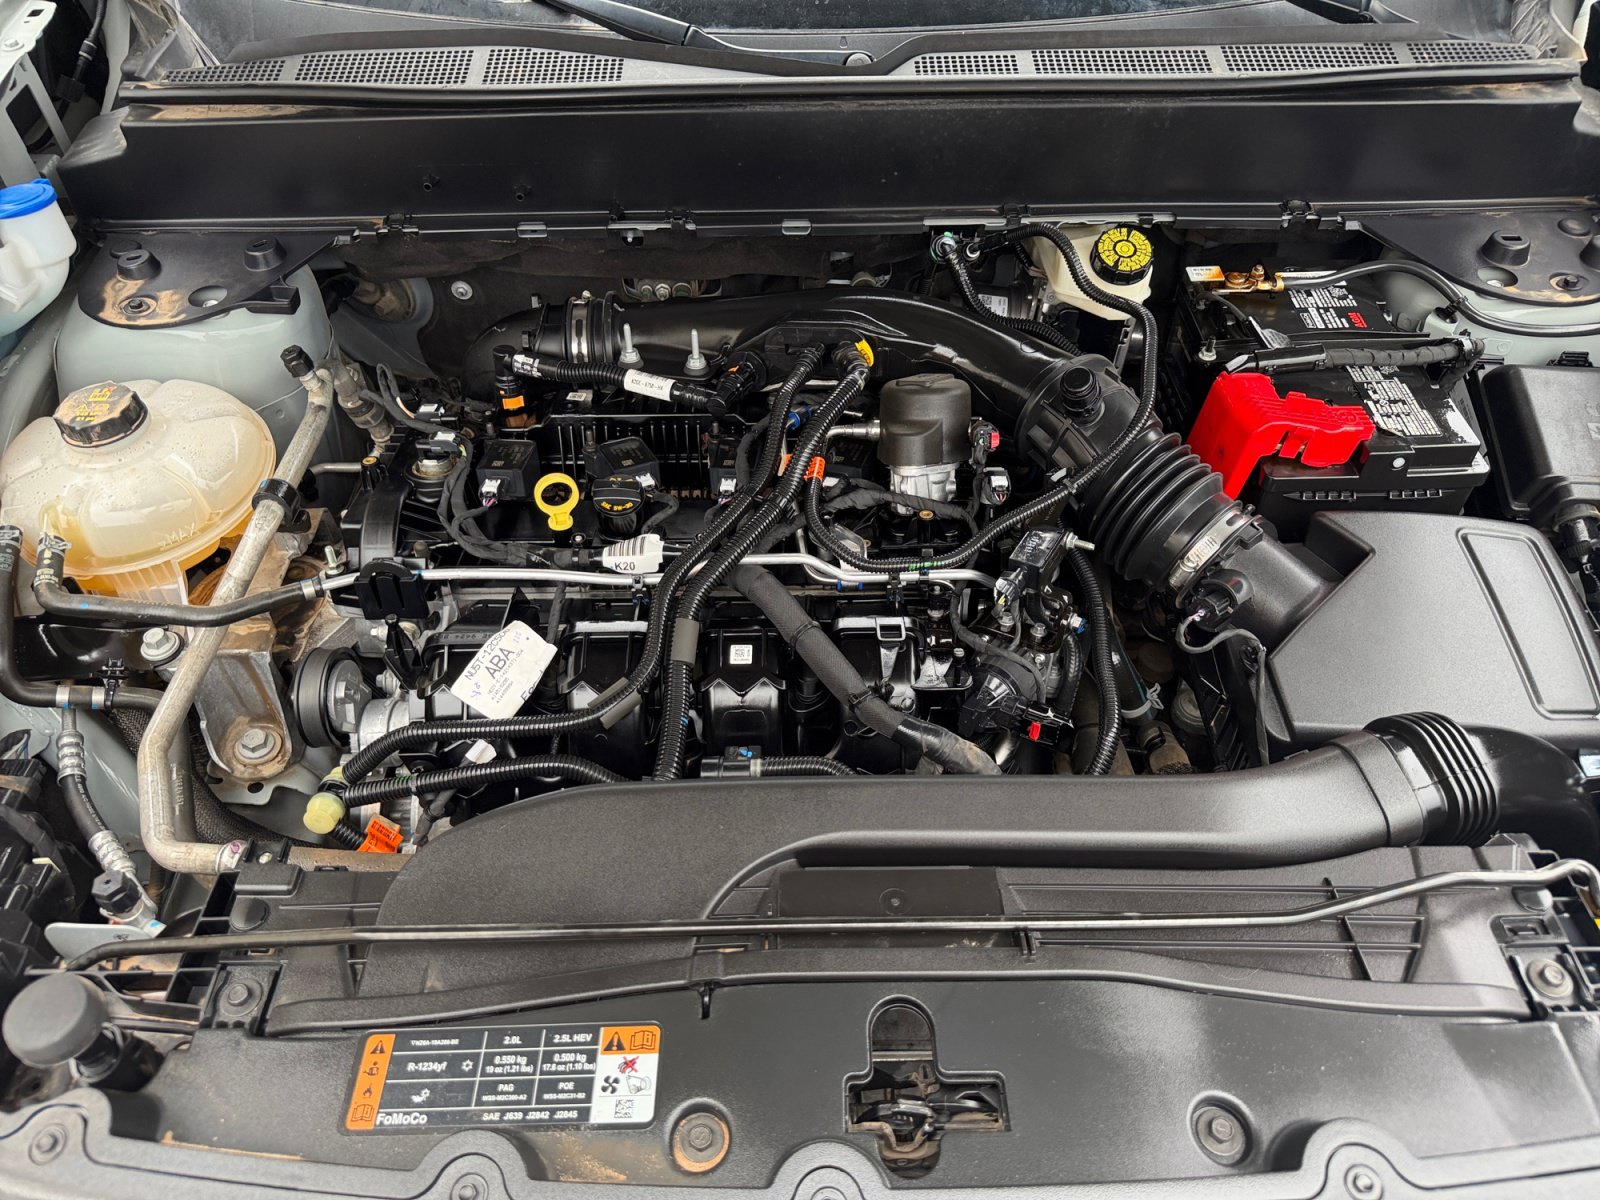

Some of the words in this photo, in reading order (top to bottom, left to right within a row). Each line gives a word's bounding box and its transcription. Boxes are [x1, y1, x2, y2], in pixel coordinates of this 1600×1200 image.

[166, 521, 200, 545] MAX
[614, 561, 636, 571] K20
[484, 647, 515, 680] ABA
[503, 1035, 522, 1045] 2.0L
[553, 1034, 572, 1043] 2.5L
[573, 1033, 593, 1042] HEV
[494, 1055, 516, 1064] 0.550
[516, 1055, 528, 1065] kg
[553, 1053, 575, 1062] 0.500
[575, 1053, 587, 1063] kg
[407, 1061, 448, 1073] R-1234yf
[485, 1065, 494, 1073] 19
[497, 1083, 515, 1092] PAG
[375, 1112, 428, 1126] FoMoCo
[482, 1112, 500, 1121] SAE
[503, 1111, 523, 1120] J639
[525, 1110, 550, 1120] J2842
[553, 1109, 579, 1119] J2845
